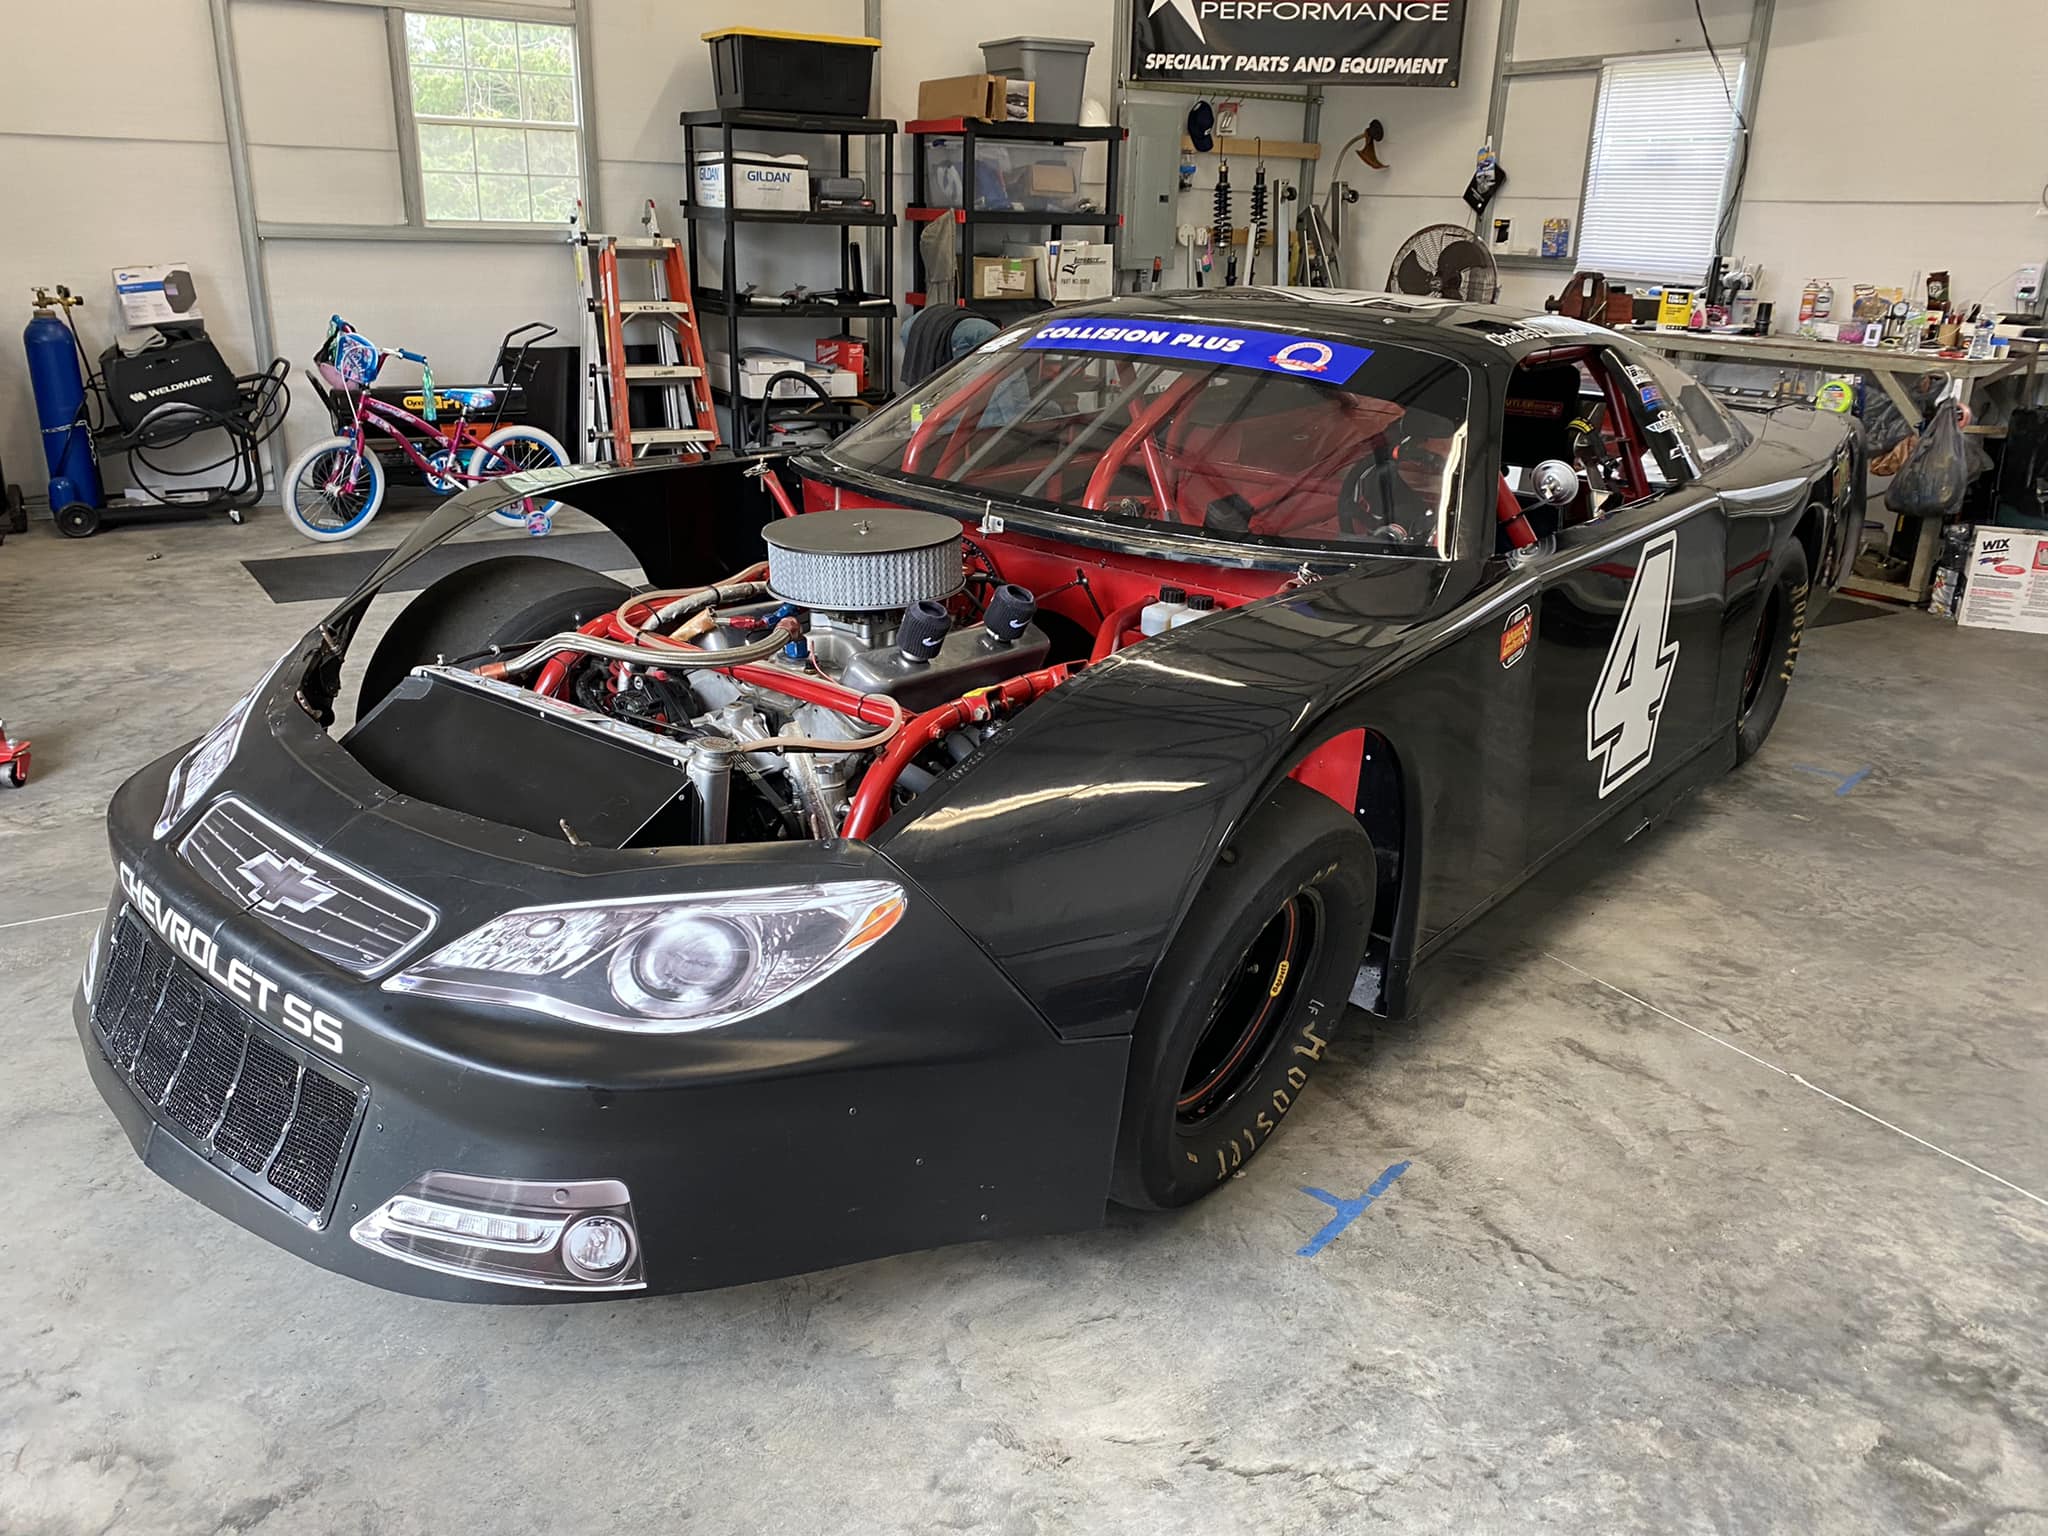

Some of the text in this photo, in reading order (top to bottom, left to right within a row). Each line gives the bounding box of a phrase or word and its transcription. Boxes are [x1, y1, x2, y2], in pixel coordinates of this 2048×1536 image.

[1199, 1, 1450, 22] PERFORMANCE
[1145, 53, 1449, 75] SPECIALTY PARTS AND EQUIPMENT
[747, 170, 791, 184] GILDAN
[1036, 326, 1166, 345] COLLISION
[1169, 333, 1246, 354] PLUS
[147, 374, 214, 398] WELDMARK
[1982, 538, 2010, 551] WIX
[1587, 529, 1680, 800] 4
[119, 860, 344, 1055] CHEVROLET SS
